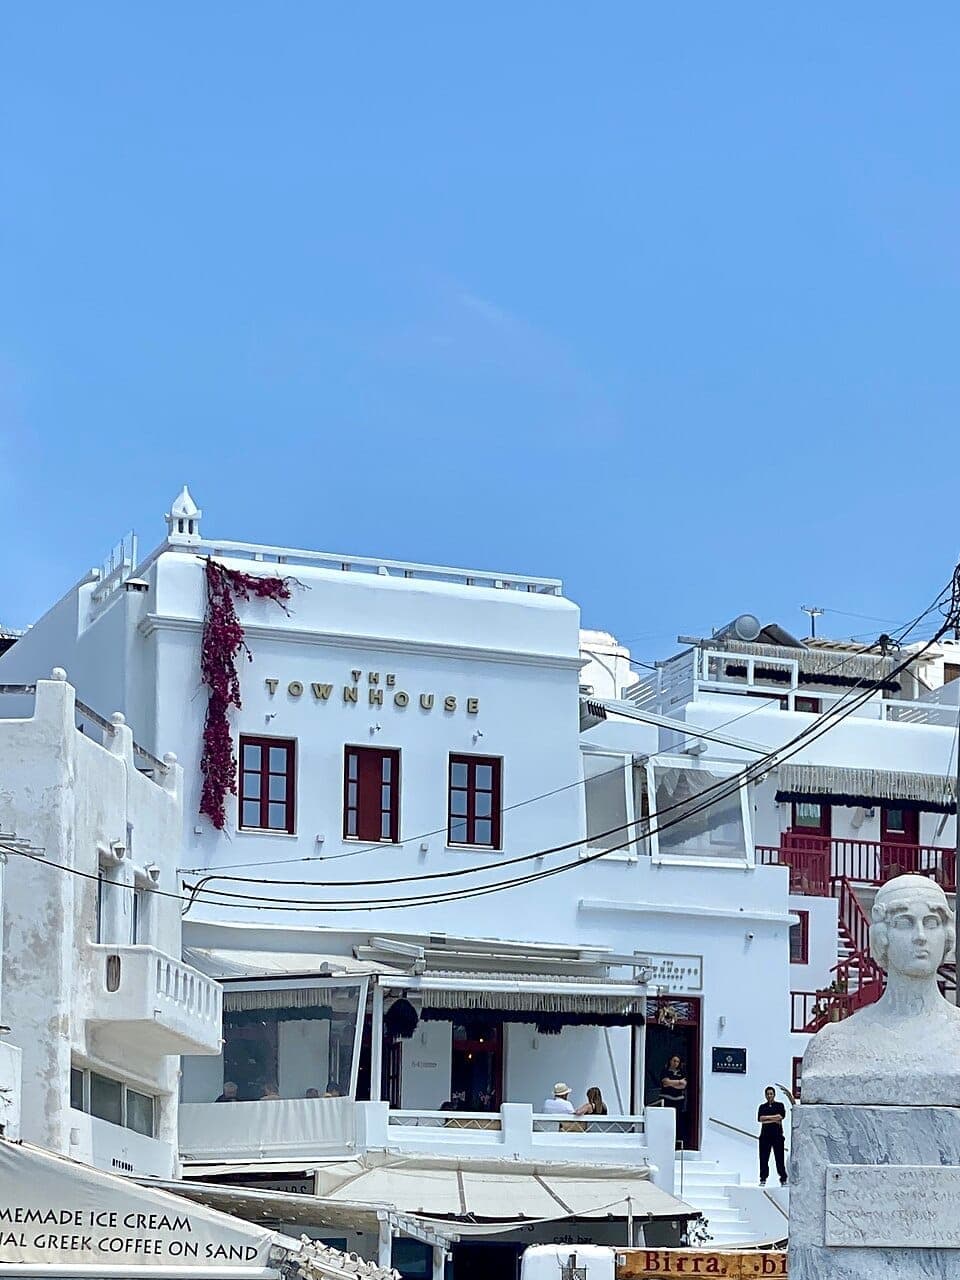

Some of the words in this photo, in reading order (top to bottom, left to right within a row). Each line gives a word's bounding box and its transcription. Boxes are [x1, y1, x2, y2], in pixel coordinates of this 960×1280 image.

[352, 670, 396, 685] THE
[265, 678, 480, 714] TOWNHOUSE
[90, 1211, 118, 1228] ICE
[123, 1213, 192, 1233] CREAM
[33, 1234, 92, 1251] GREEK
[98, 1237, 163, 1255] COFFEE
[168, 1241, 199, 1257] ON
[205, 1243, 259, 1261] SAND
